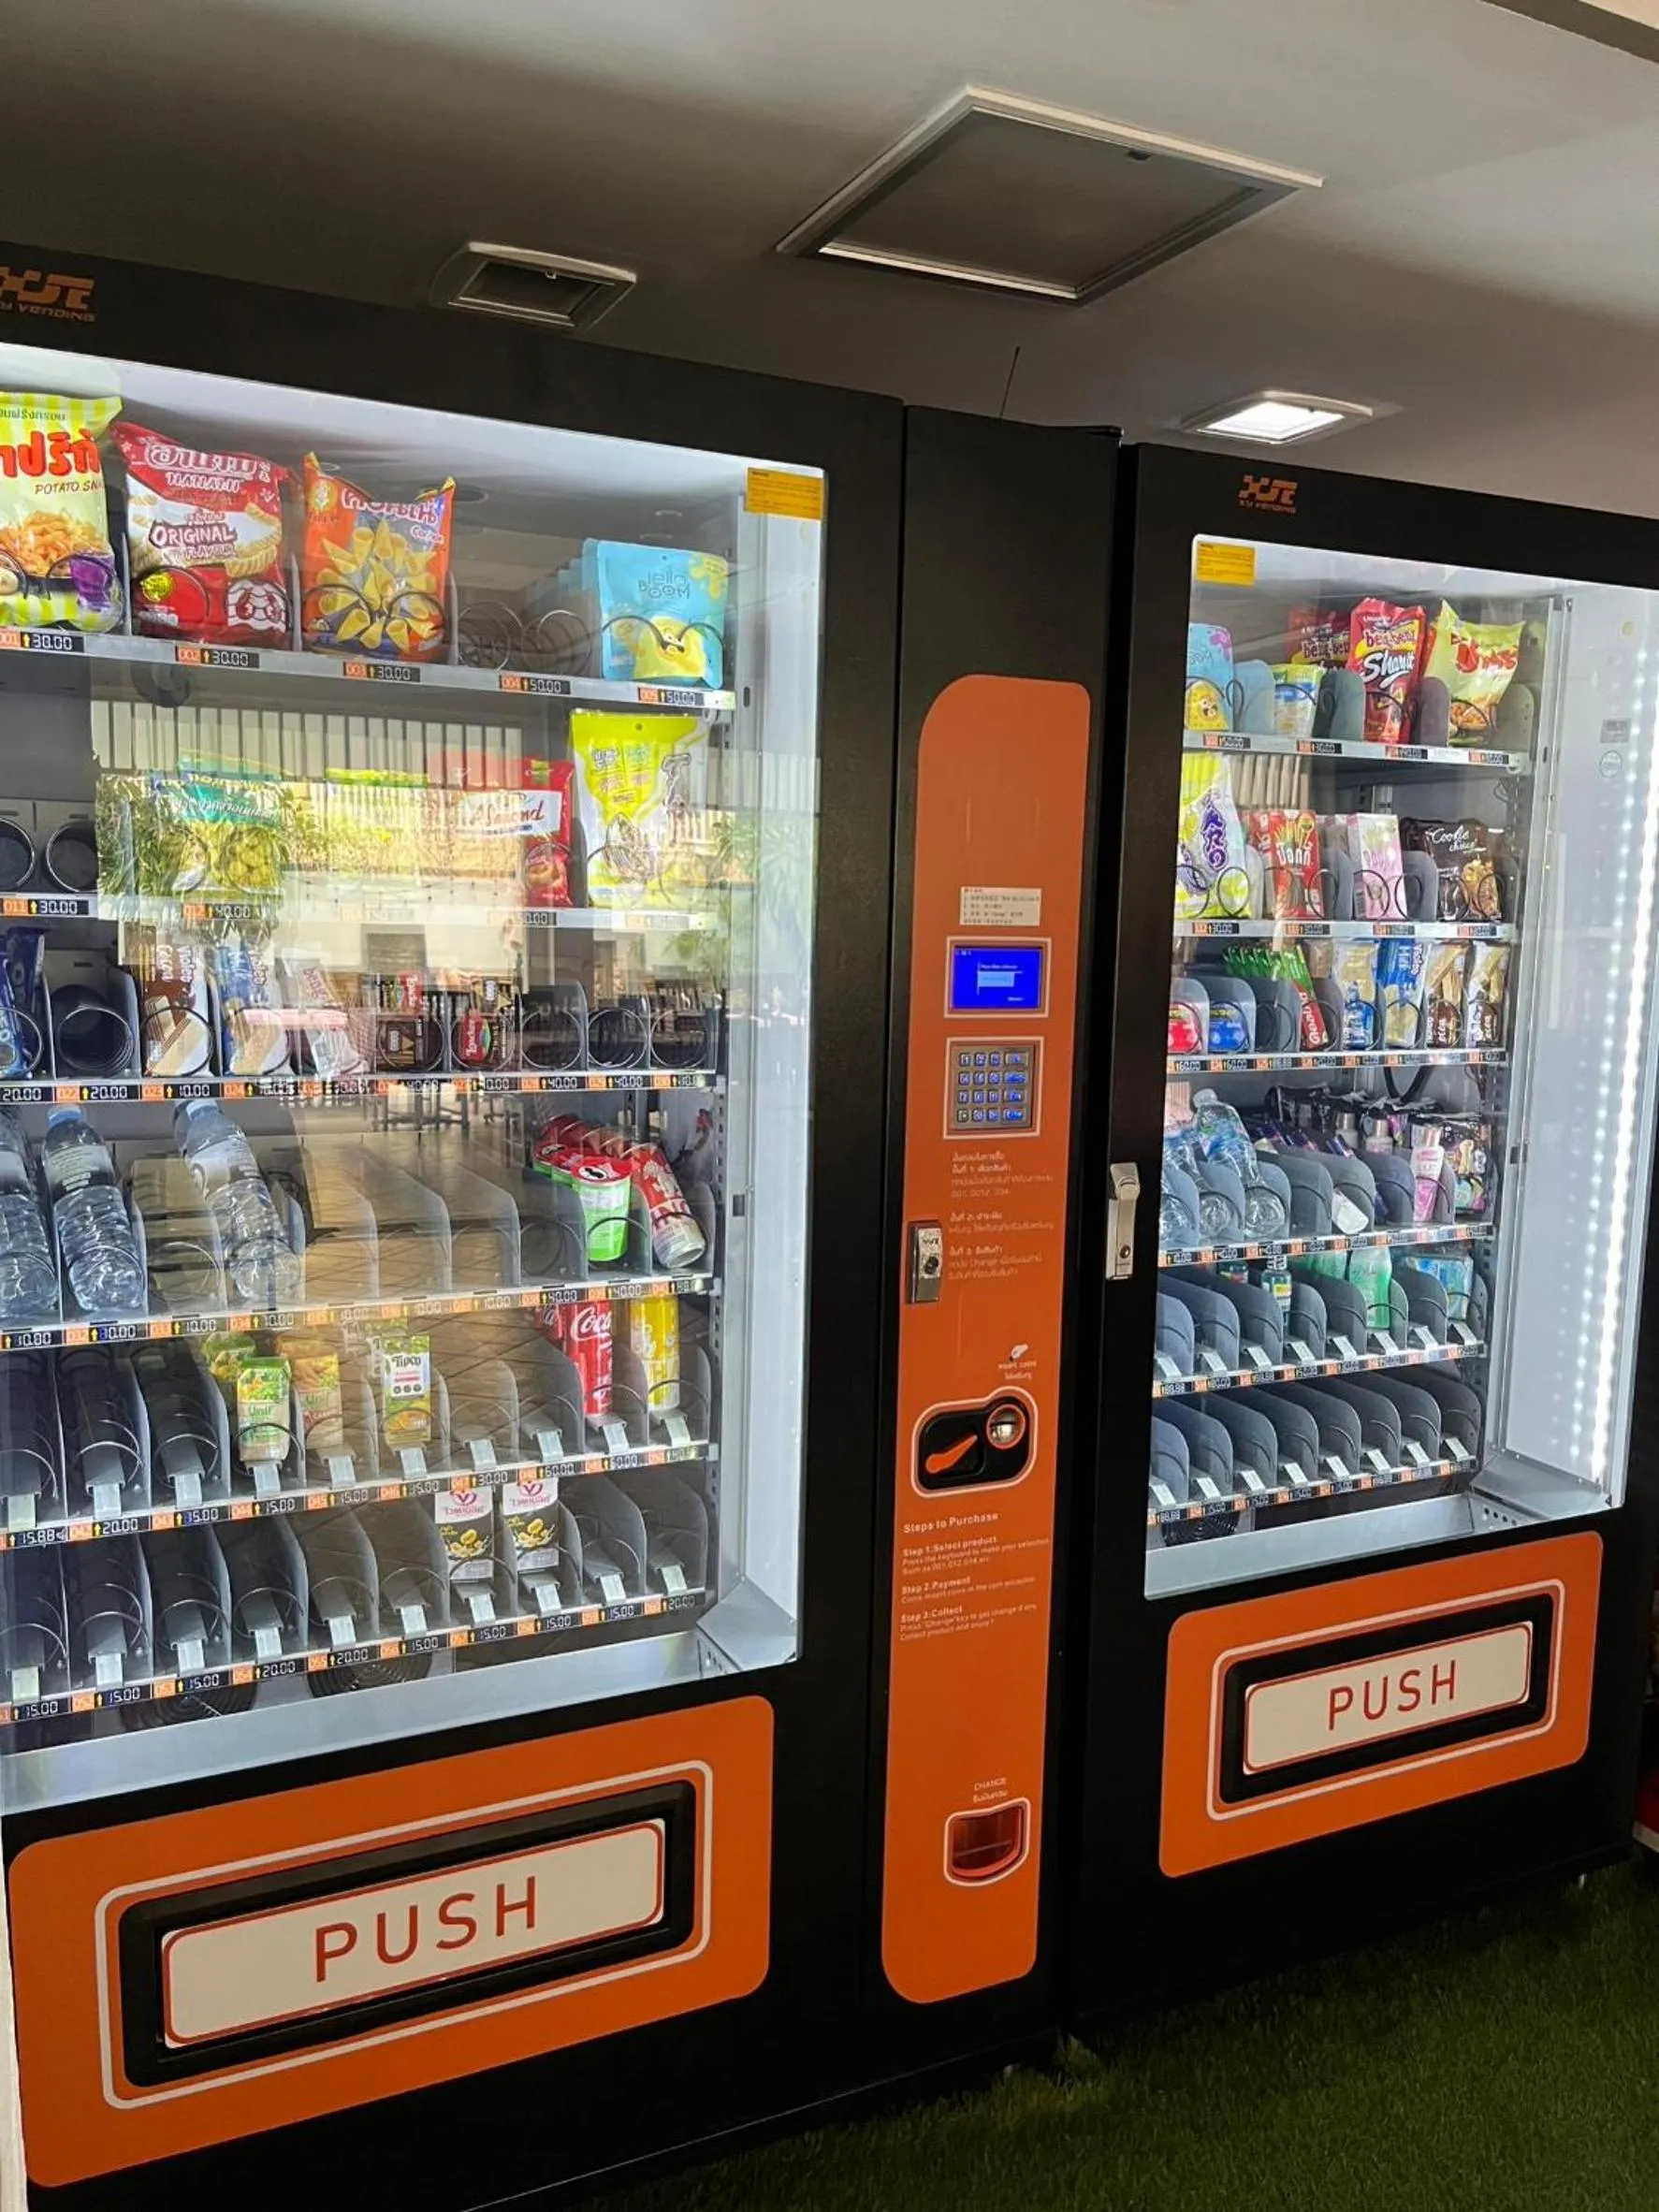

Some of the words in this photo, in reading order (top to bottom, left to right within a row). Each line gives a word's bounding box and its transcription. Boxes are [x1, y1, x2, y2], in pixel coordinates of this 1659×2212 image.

[35, 480, 80, 495] POTATO
[151, 523, 234, 547] ORIGINAL
[32, 633, 73, 650] 30.00
[212, 651, 249, 666] 30.00
[377, 666, 411, 680] 30.00
[530, 677, 561, 692] 50.00
[39, 900, 79, 914] 30.00
[213, 905, 252, 918] 40.00
[547, 1077, 577, 1088] 40.00
[3, 1087, 42, 1101] 20.00
[91, 1086, 128, 1099] 20.00
[180, 1084, 211, 1098] 10.00
[613, 1285, 642, 1296] 40.00
[186, 1319, 217, 1332] 10.00
[391, 1355, 421, 1368] Tipco
[477, 1471, 508, 1485] 30.00
[265, 1498, 296, 1514] 15.00
[102, 1518, 138, 1535] 20.00
[903, 1522, 935, 1534] Steps
[937, 1519, 947, 1529] to
[949, 1513, 999, 1527] Purchase
[546, 1615, 572, 1629] 15.00
[480, 1625, 506, 1640] 15.00
[411, 1637, 439, 1652] 15.00
[337, 1649, 370, 1665] 20.00
[263, 1661, 296, 1678] 20.00
[109, 1686, 141, 1706] 15.00
[1328, 1660, 1456, 1731] PUSH
[25, 1700, 59, 1718] 15.00
[314, 1876, 535, 1983] PUSH
